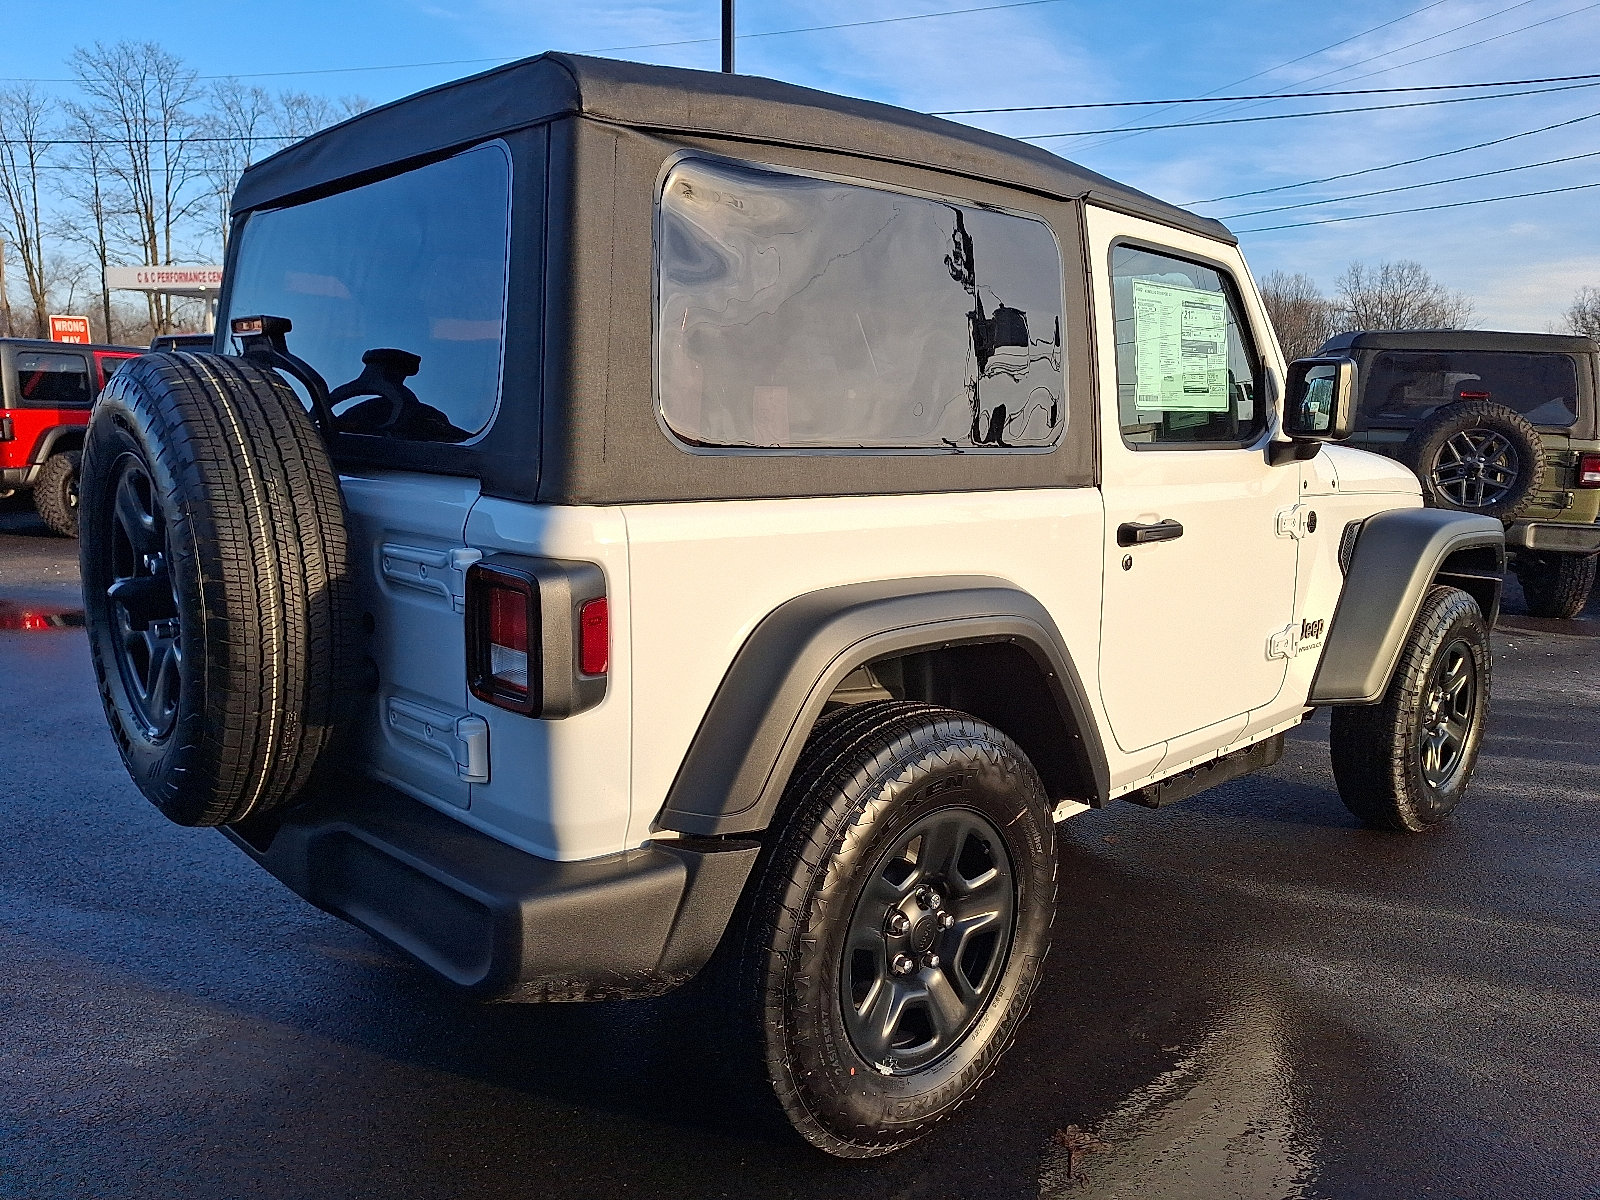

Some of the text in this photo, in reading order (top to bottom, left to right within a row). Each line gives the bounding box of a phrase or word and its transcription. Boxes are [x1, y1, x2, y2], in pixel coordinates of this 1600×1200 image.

[137, 272, 142, 283] C
[144, 272, 149, 283] &
[151, 272, 156, 283] C
[157, 271, 207, 283] PERFORMANCE
[54, 320, 85, 333] WRONG
[1299, 617, 1325, 642] Jeep
